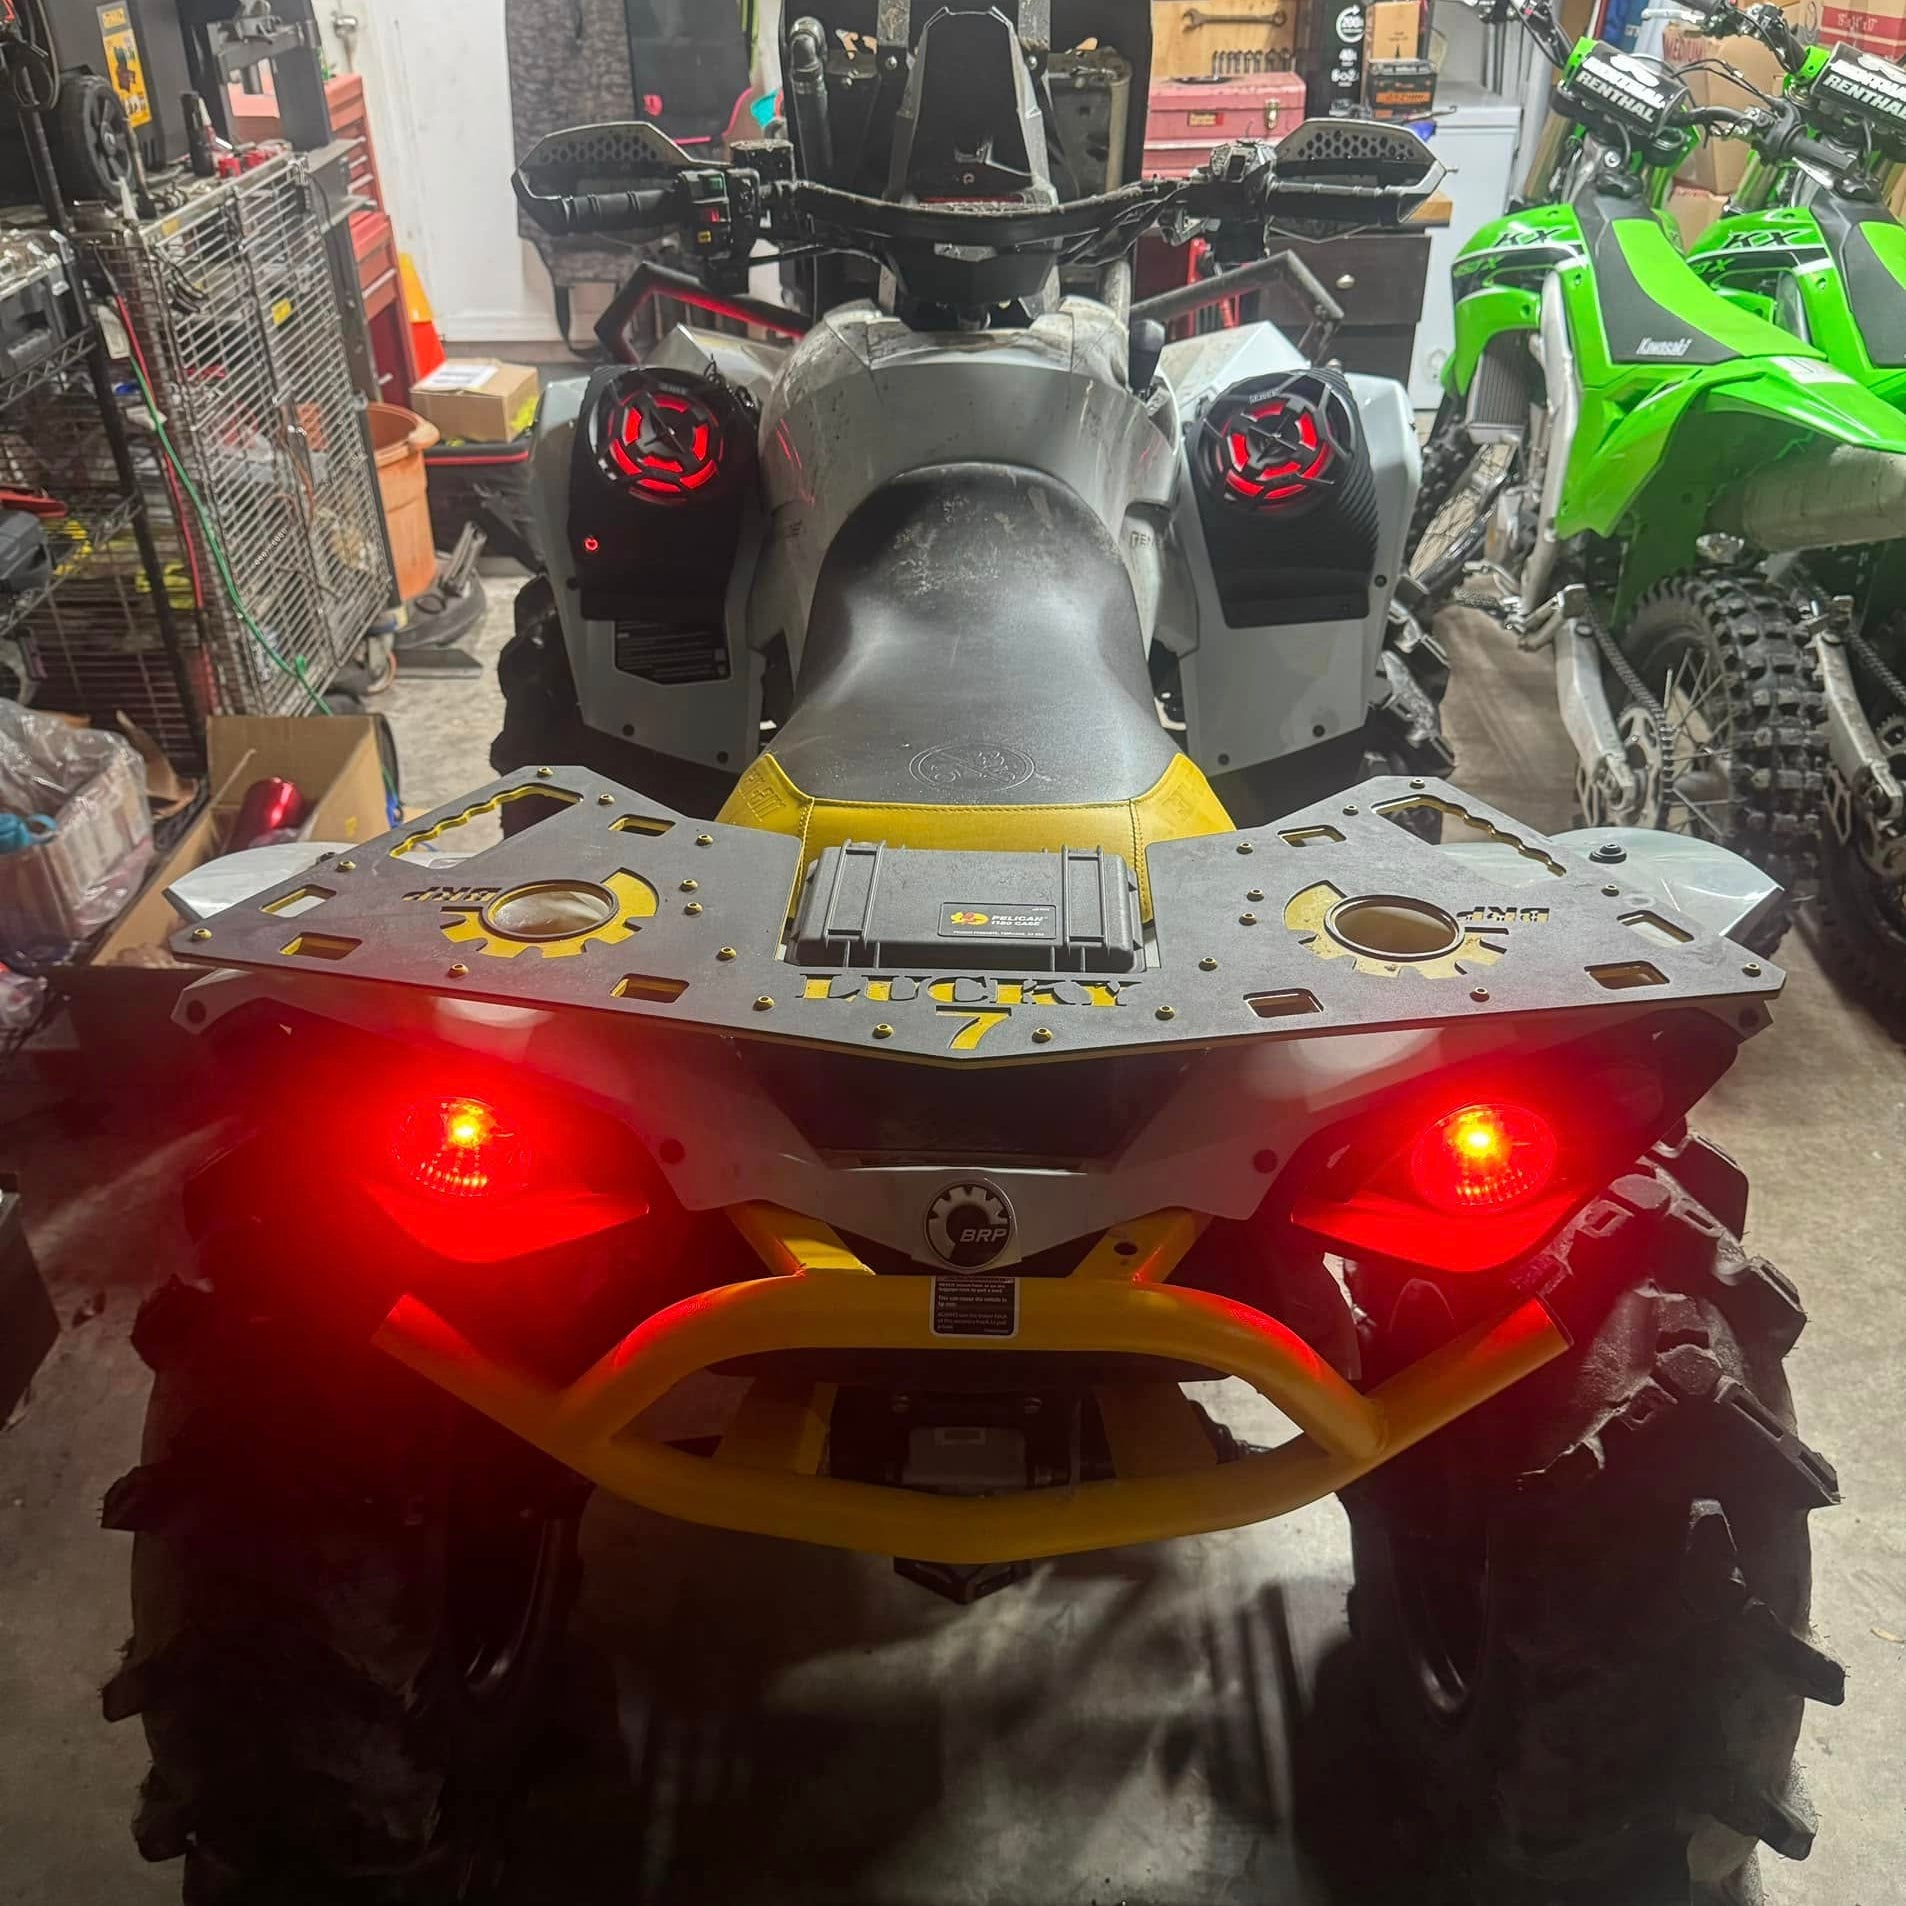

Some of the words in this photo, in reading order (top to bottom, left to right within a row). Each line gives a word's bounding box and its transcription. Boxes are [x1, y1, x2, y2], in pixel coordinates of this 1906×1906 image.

[1575, 70, 1655, 123] RENTHAL
[1492, 226, 1573, 248] KX
[1721, 227, 1814, 249] KX
[796, 973, 1143, 1006] LUCKY
[936, 1004, 1012, 1051] 7
[960, 1228, 1008, 1243] BRP
